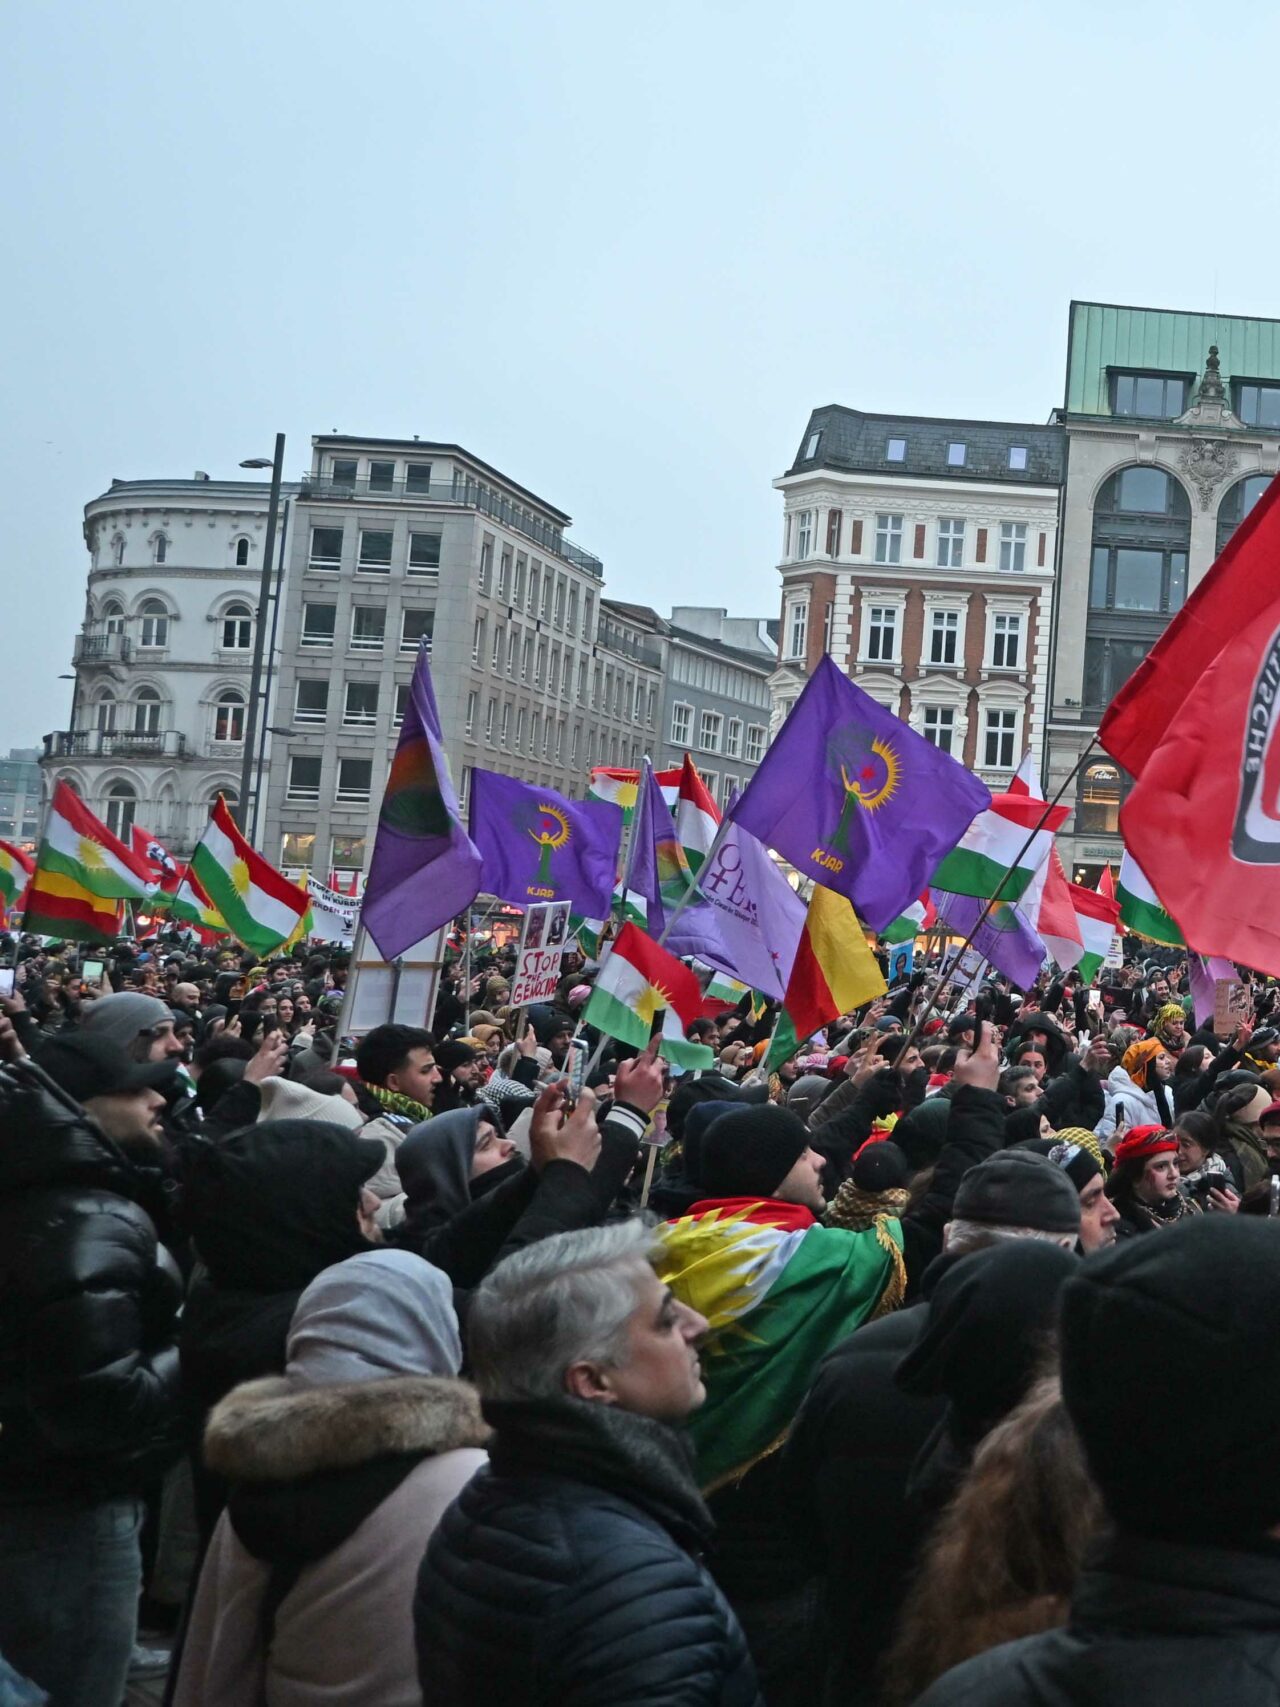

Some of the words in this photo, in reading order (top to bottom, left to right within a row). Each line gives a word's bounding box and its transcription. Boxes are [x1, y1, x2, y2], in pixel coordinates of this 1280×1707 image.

[810, 848, 845, 874] KJAR
[527, 886, 555, 899] KJAR
[520, 951, 560, 977] STOP
[527, 971, 542, 984] THE
